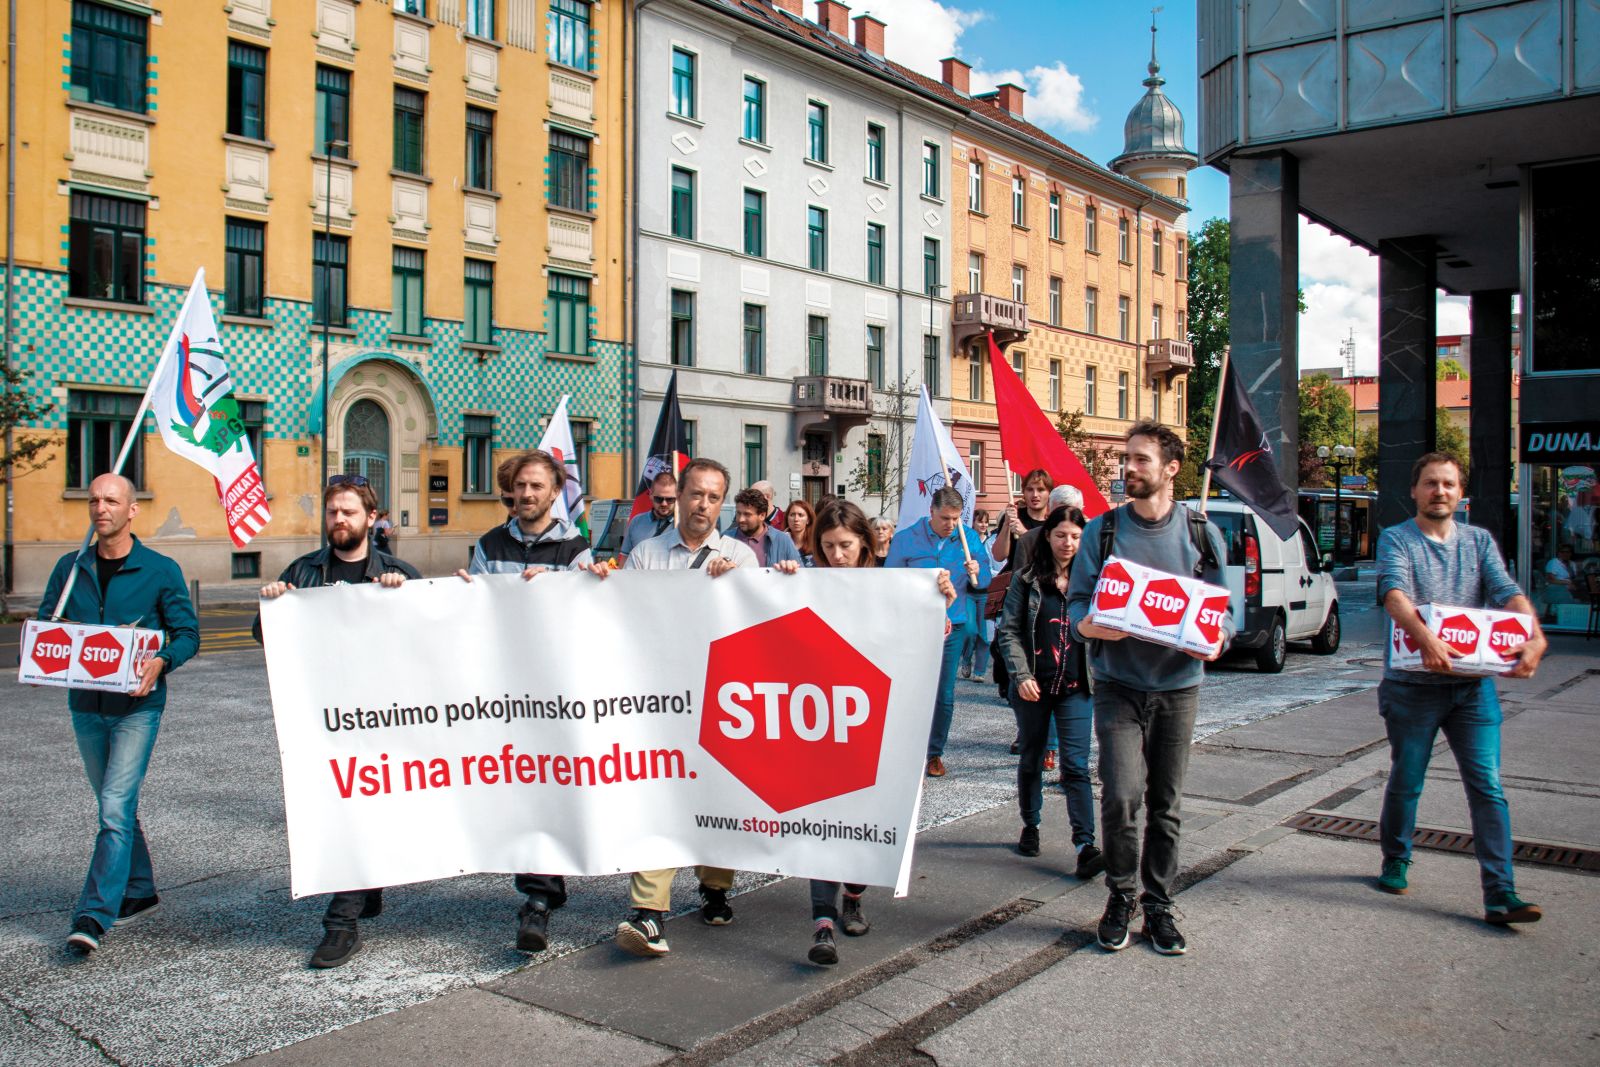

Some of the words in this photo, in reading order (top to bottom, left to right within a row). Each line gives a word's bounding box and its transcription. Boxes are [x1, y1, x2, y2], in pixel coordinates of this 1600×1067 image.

[226, 472, 256, 512] NDIKAT
[1143, 590, 1186, 614] STOP
[35, 642, 72, 660] STOP
[1441, 627, 1477, 645] STOP
[82, 645, 121, 664] STOP
[323, 702, 439, 732] Ustavimo
[445, 694, 587, 728] pokojninsko
[593, 690, 692, 724] prevaro!
[717, 681, 871, 744] STOP
[328, 752, 393, 799] Vsi
[402, 758, 452, 792] na
[461, 741, 699, 788] referendum.
[695, 814, 897, 847] www.stoppokojninski.si
